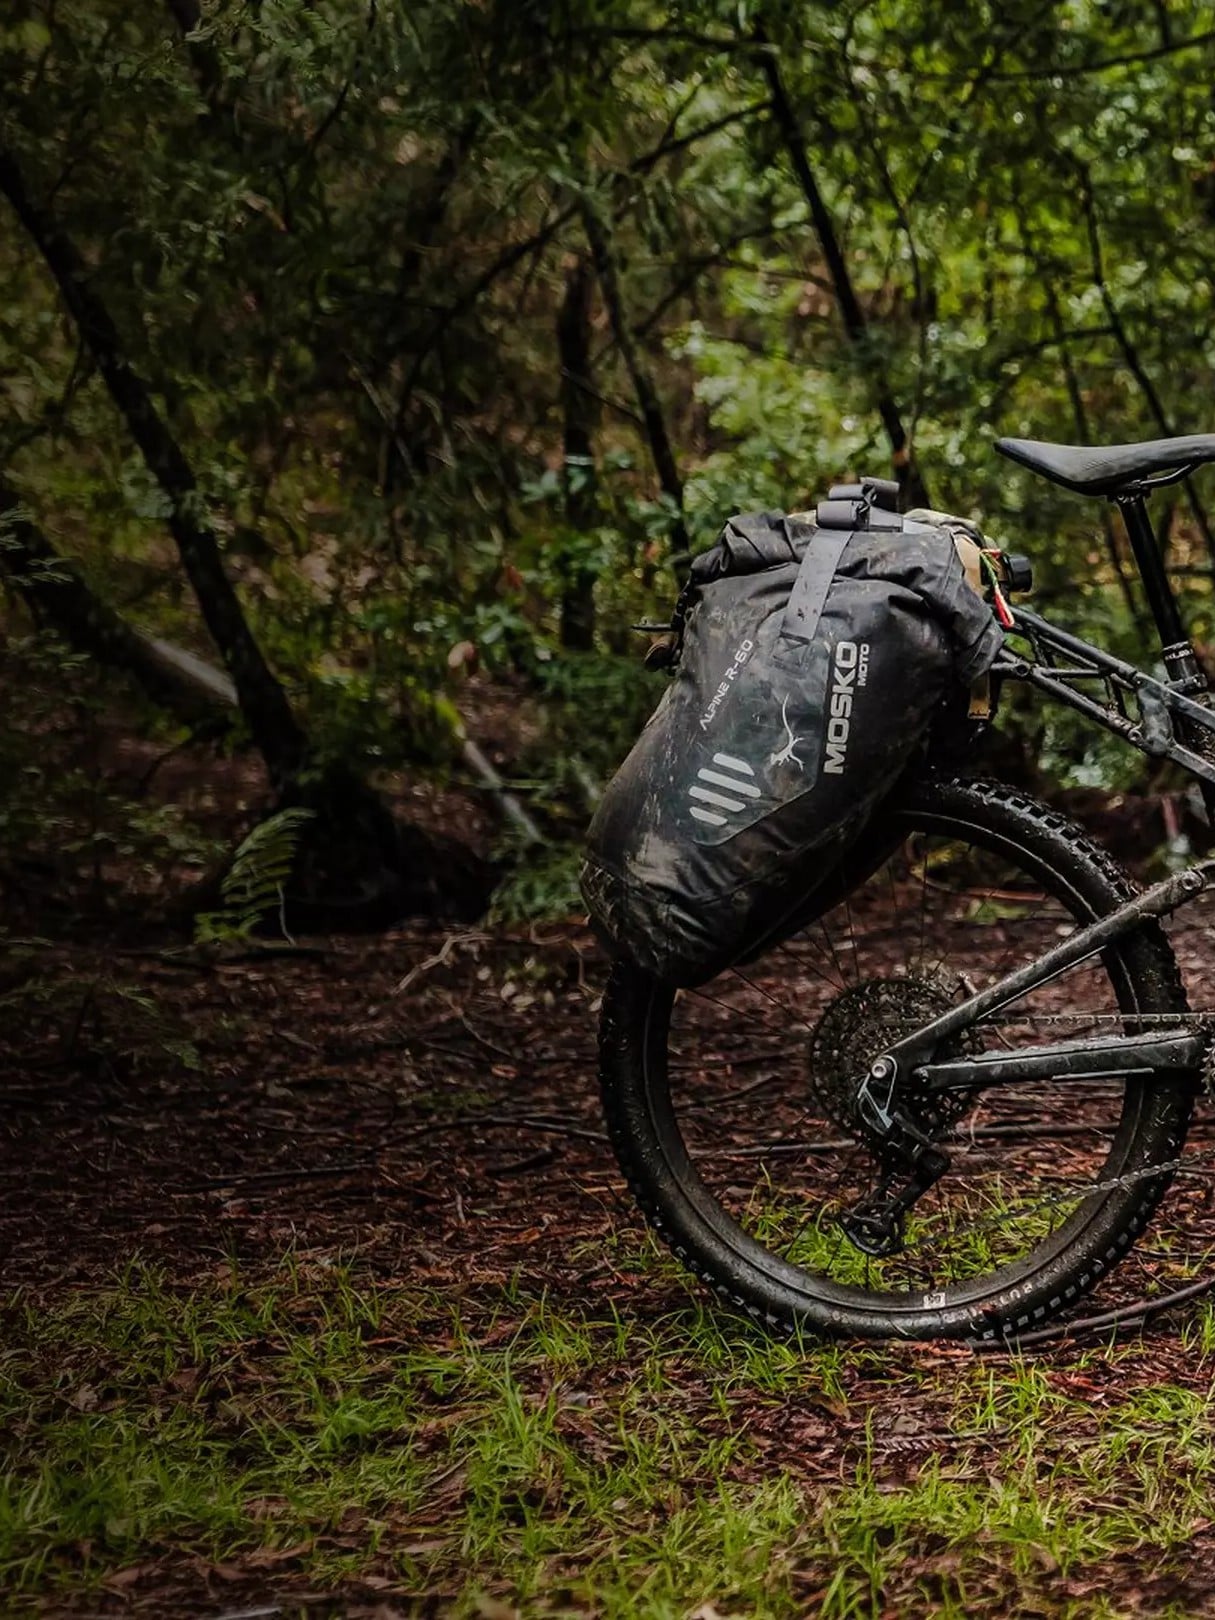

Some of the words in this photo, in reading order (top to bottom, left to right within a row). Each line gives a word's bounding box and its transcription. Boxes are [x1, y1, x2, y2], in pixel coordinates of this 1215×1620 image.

[699, 681, 730, 731] ALPINE
[724, 639, 753, 681] R-60
[823, 641, 858, 774] MOSKO
[857, 643, 870, 687] MOTO
